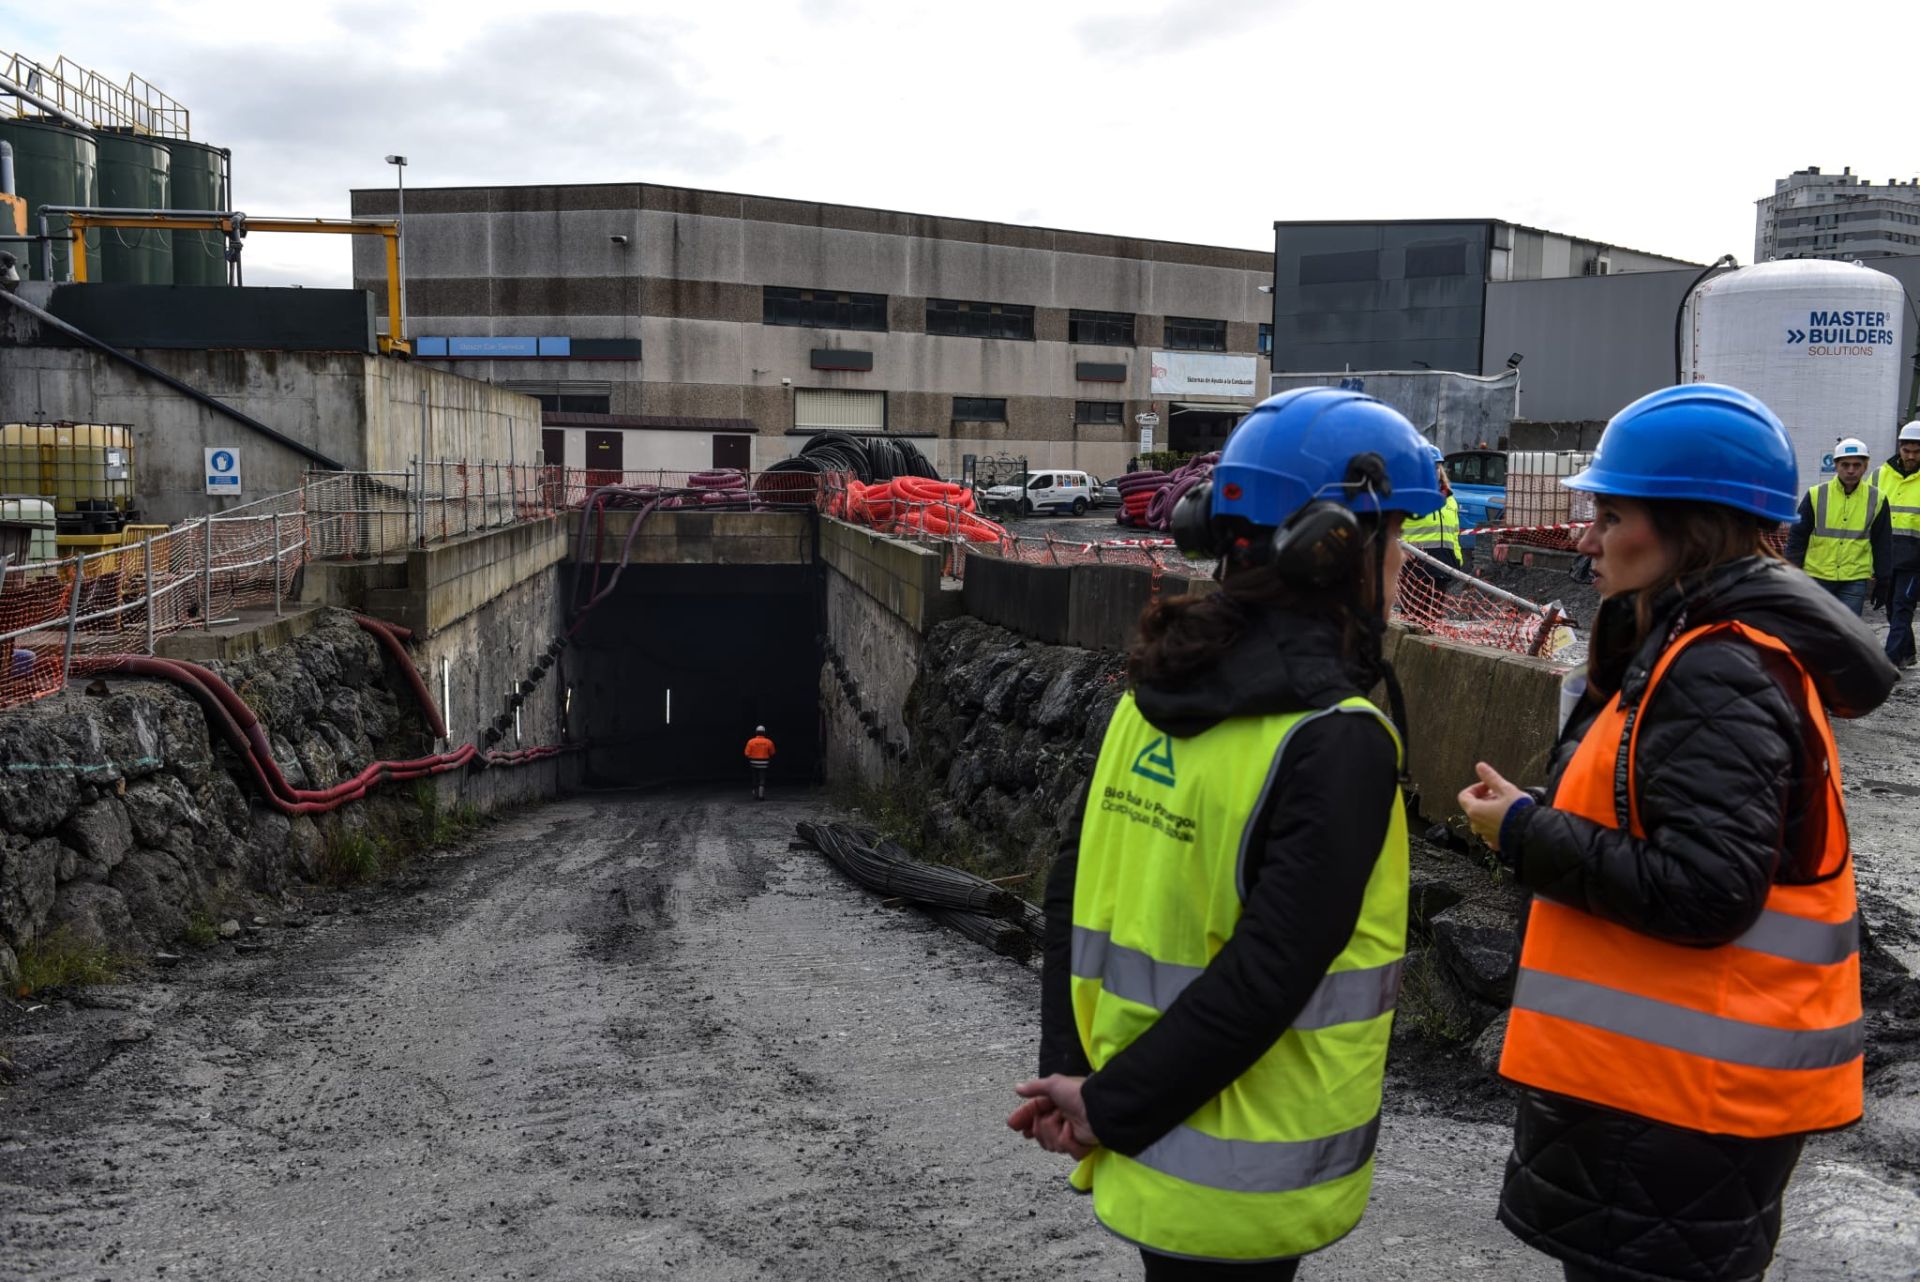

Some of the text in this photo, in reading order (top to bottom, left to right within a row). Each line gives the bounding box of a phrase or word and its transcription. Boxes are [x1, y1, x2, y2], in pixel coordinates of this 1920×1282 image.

[1810, 311, 1885, 326] MASTER
[1809, 329, 1893, 345] BUILDERS
[1808, 346, 1873, 356] SOLUTIONS
